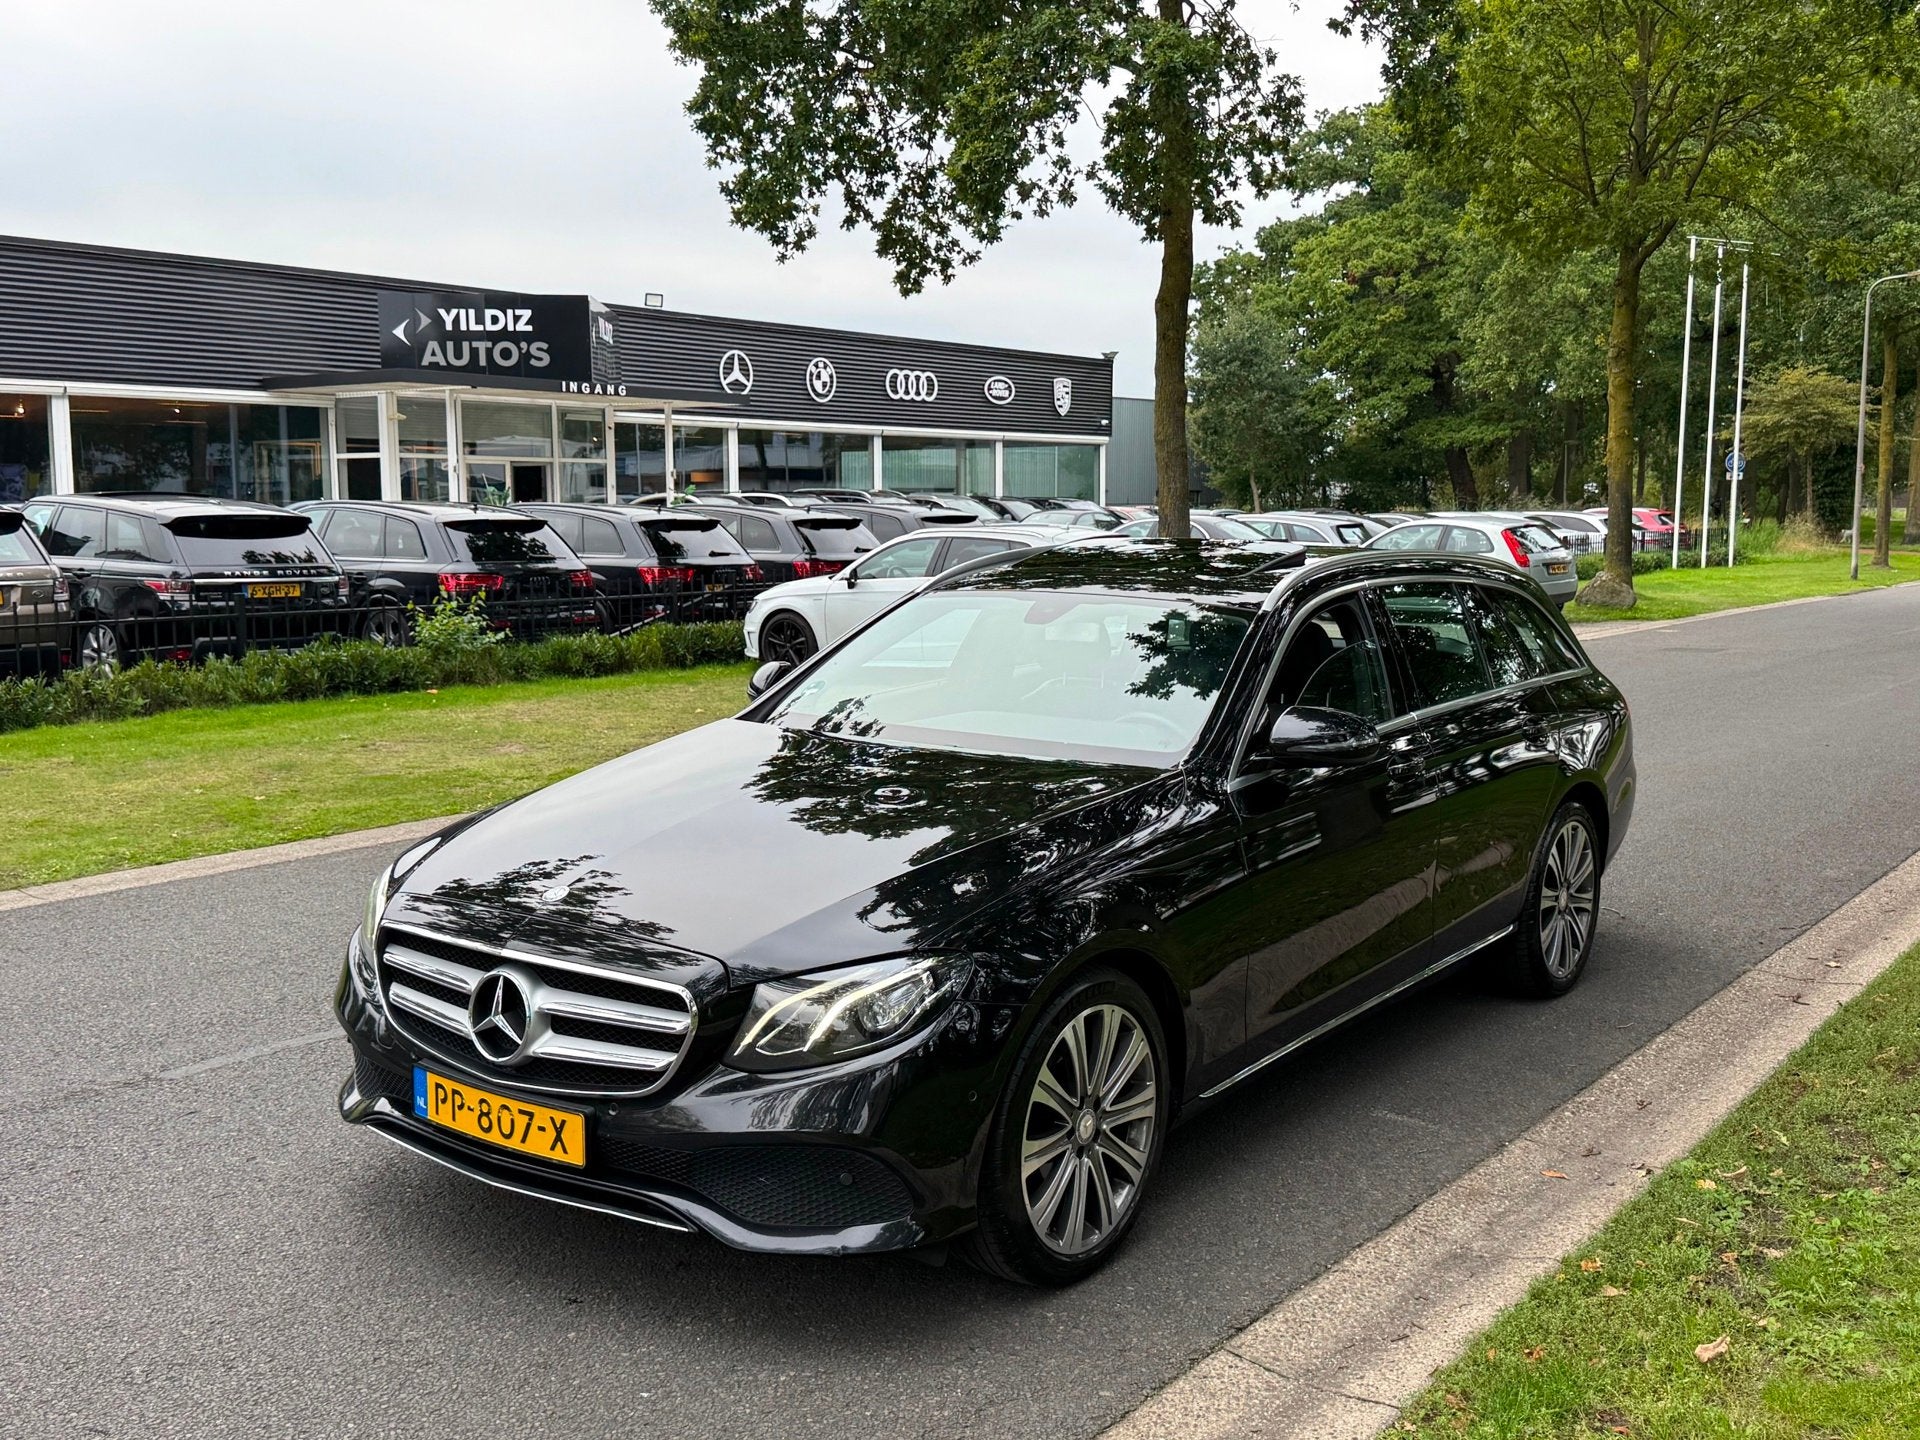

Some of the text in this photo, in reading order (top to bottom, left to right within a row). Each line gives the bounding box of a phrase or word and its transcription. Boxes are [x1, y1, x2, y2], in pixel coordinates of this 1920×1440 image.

[437, 308, 533, 332] YILDIZ
[421, 341, 550, 368] AUTO'S
[562, 381, 627, 396] INGANG
[416, 1096, 427, 1109] NL
[434, 1082, 569, 1155] PP-807-X
